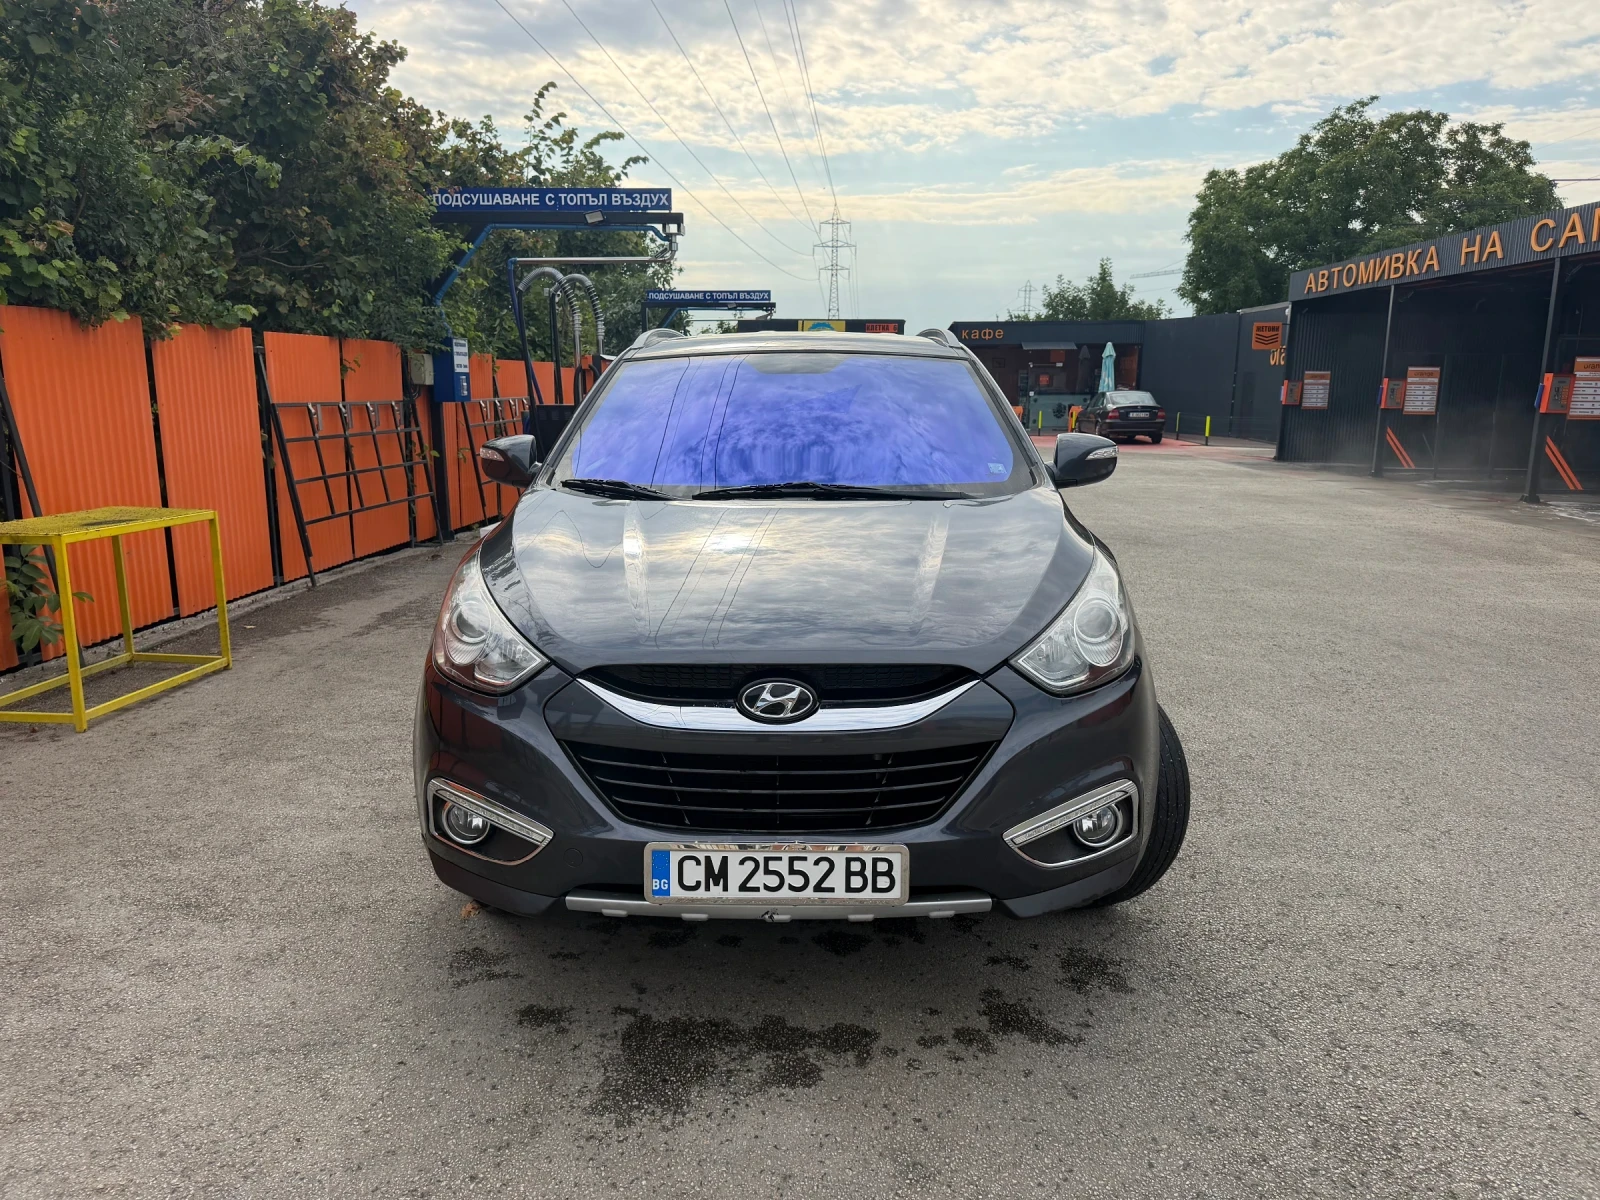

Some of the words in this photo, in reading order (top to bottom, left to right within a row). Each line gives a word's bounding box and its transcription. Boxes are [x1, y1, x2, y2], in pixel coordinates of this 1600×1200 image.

[433, 193, 540, 207] ПОДСУШАВАНЕ
[545, 193, 555, 206] С
[560, 193, 608, 206] ТОПЪЛ
[611, 193, 669, 208] ВЪЗДУХ
[1304, 246, 1440, 294] АВТОМИВКА
[1460, 231, 1504, 266] НА
[649, 292, 704, 300] ПОДСУШАВАНЕ
[705, 292, 711, 300] С
[713, 292, 738, 300] ТОПЪЛ
[740, 292, 769, 300] ВЪЗДУХ
[961, 328, 1004, 340] кафе
[652, 879, 669, 890] BG
[677, 855, 729, 892] CM
[738, 856, 836, 893] 2552
[845, 856, 896, 894] BB
